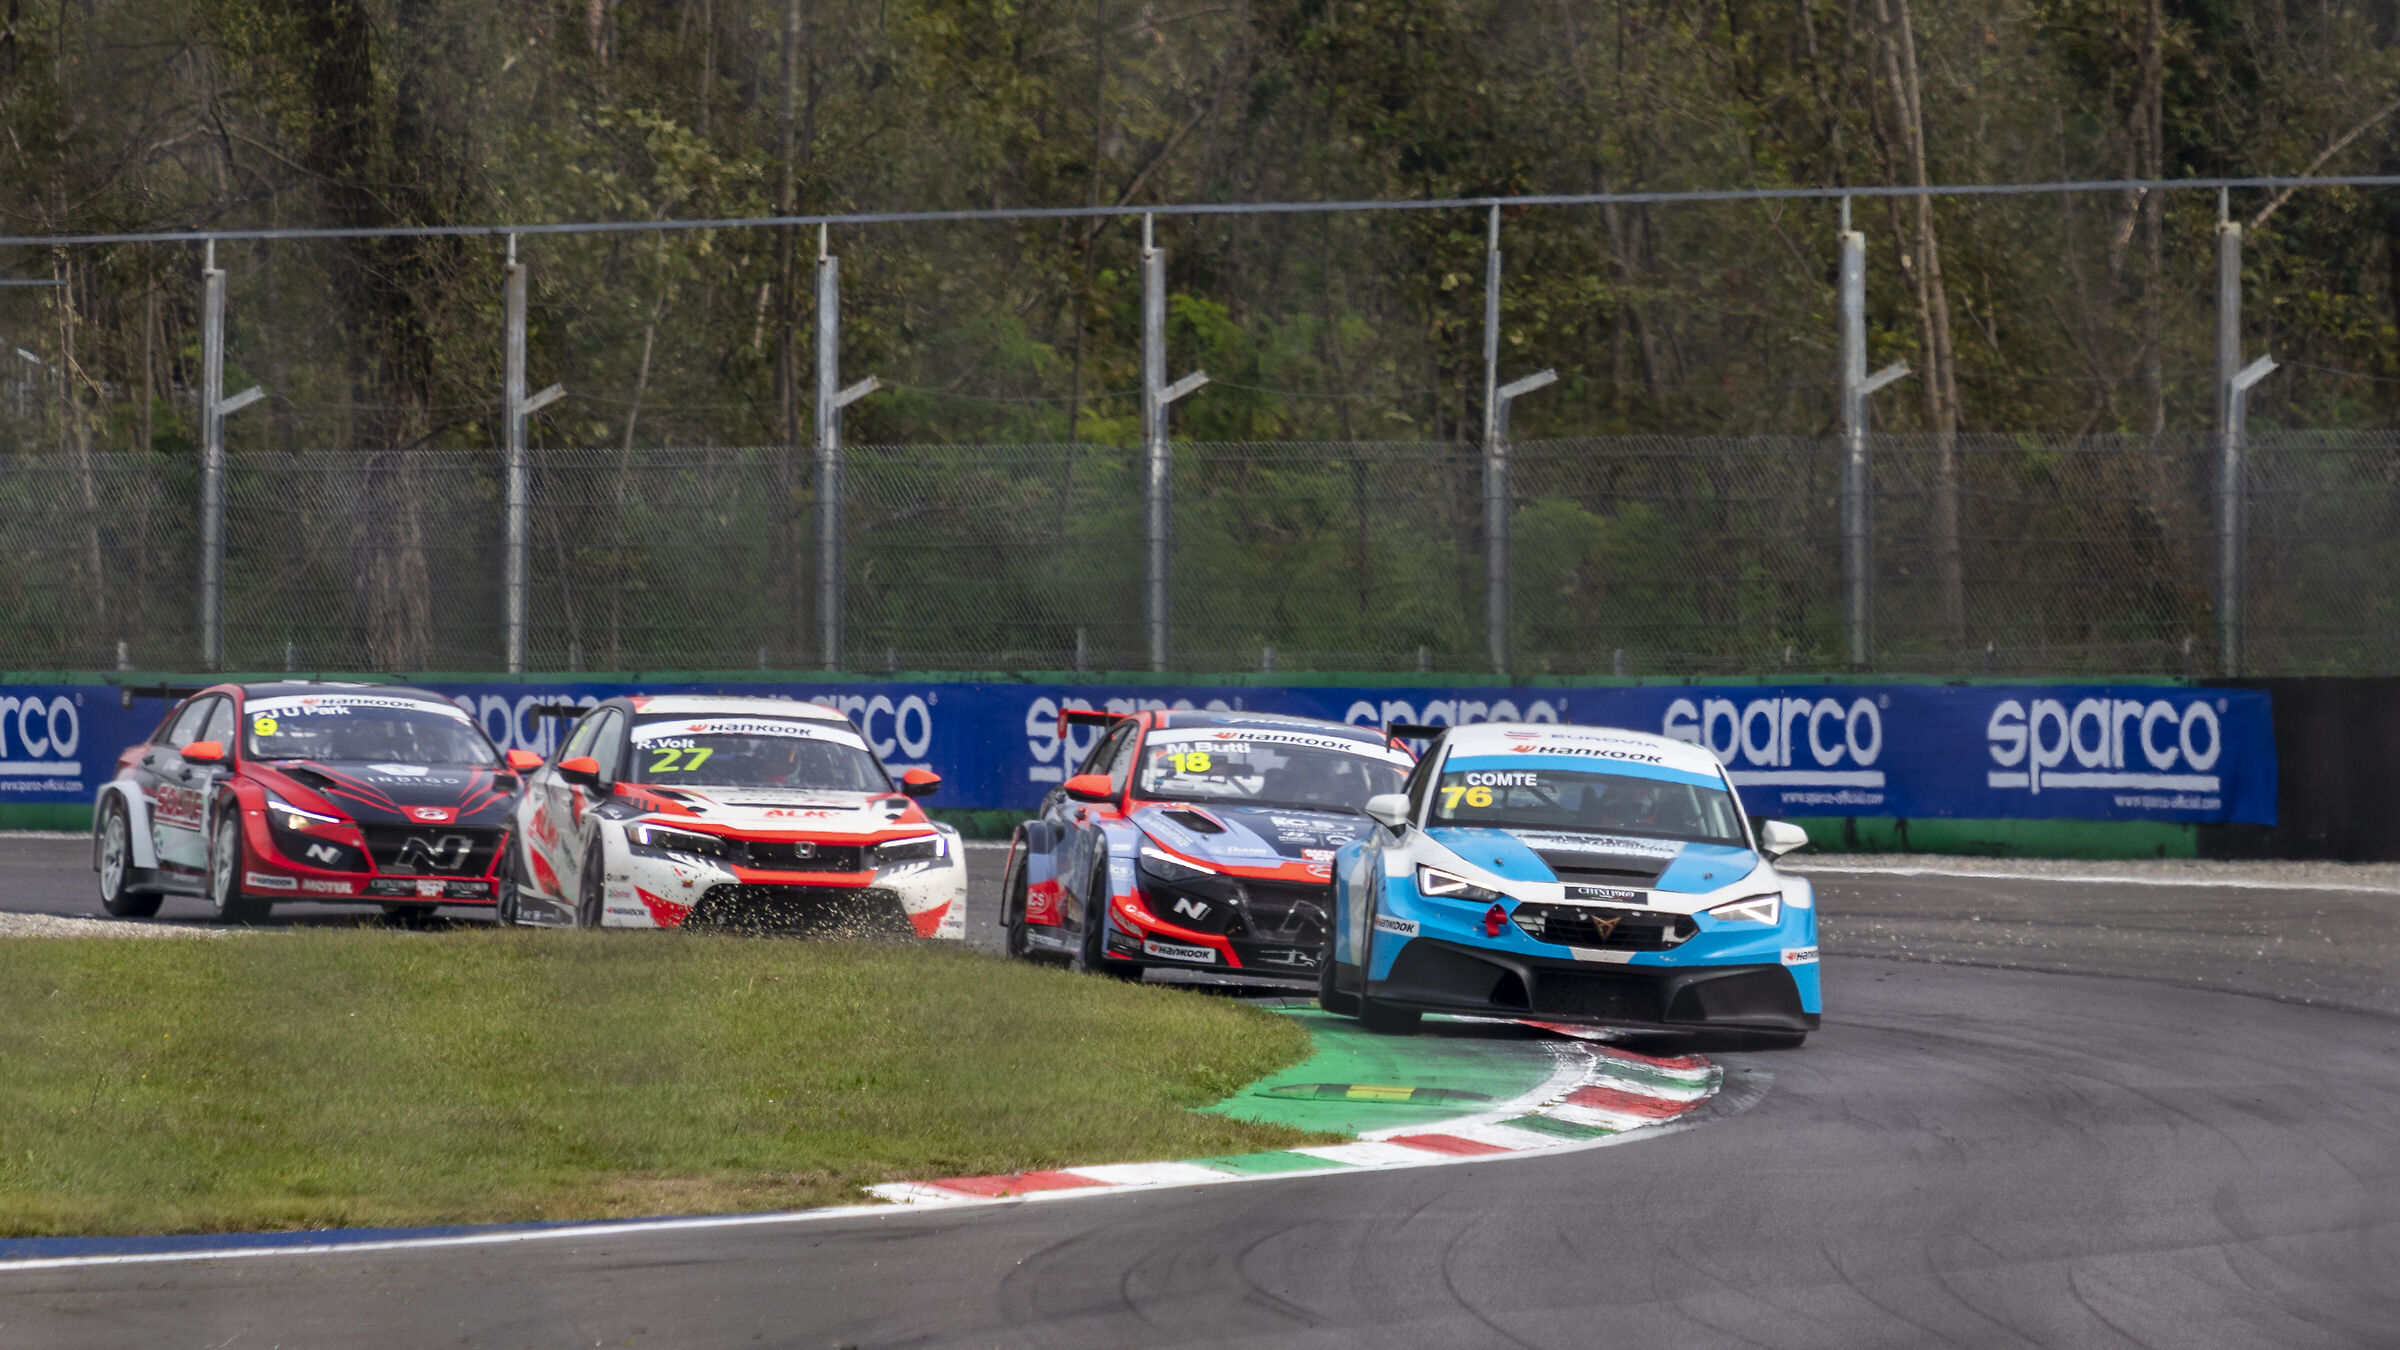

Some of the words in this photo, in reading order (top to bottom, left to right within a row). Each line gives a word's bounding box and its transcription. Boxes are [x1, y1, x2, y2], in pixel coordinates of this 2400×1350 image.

[302, 705, 351, 717] Park
[254, 717, 278, 737] 9
[1663, 698, 1882, 766] sparco
[636, 737, 696, 750] R.Volt
[1166, 742, 1251, 754] M.Butti
[1551, 733, 1659, 749] EUROVIA
[1987, 699, 2221, 795] sparco
[648, 747, 714, 774] 27
[1168, 752, 1212, 773] 18
[1466, 772, 1538, 787] COMTE
[1441, 786, 1493, 809] 76
[302, 879, 353, 894] MOTUL
